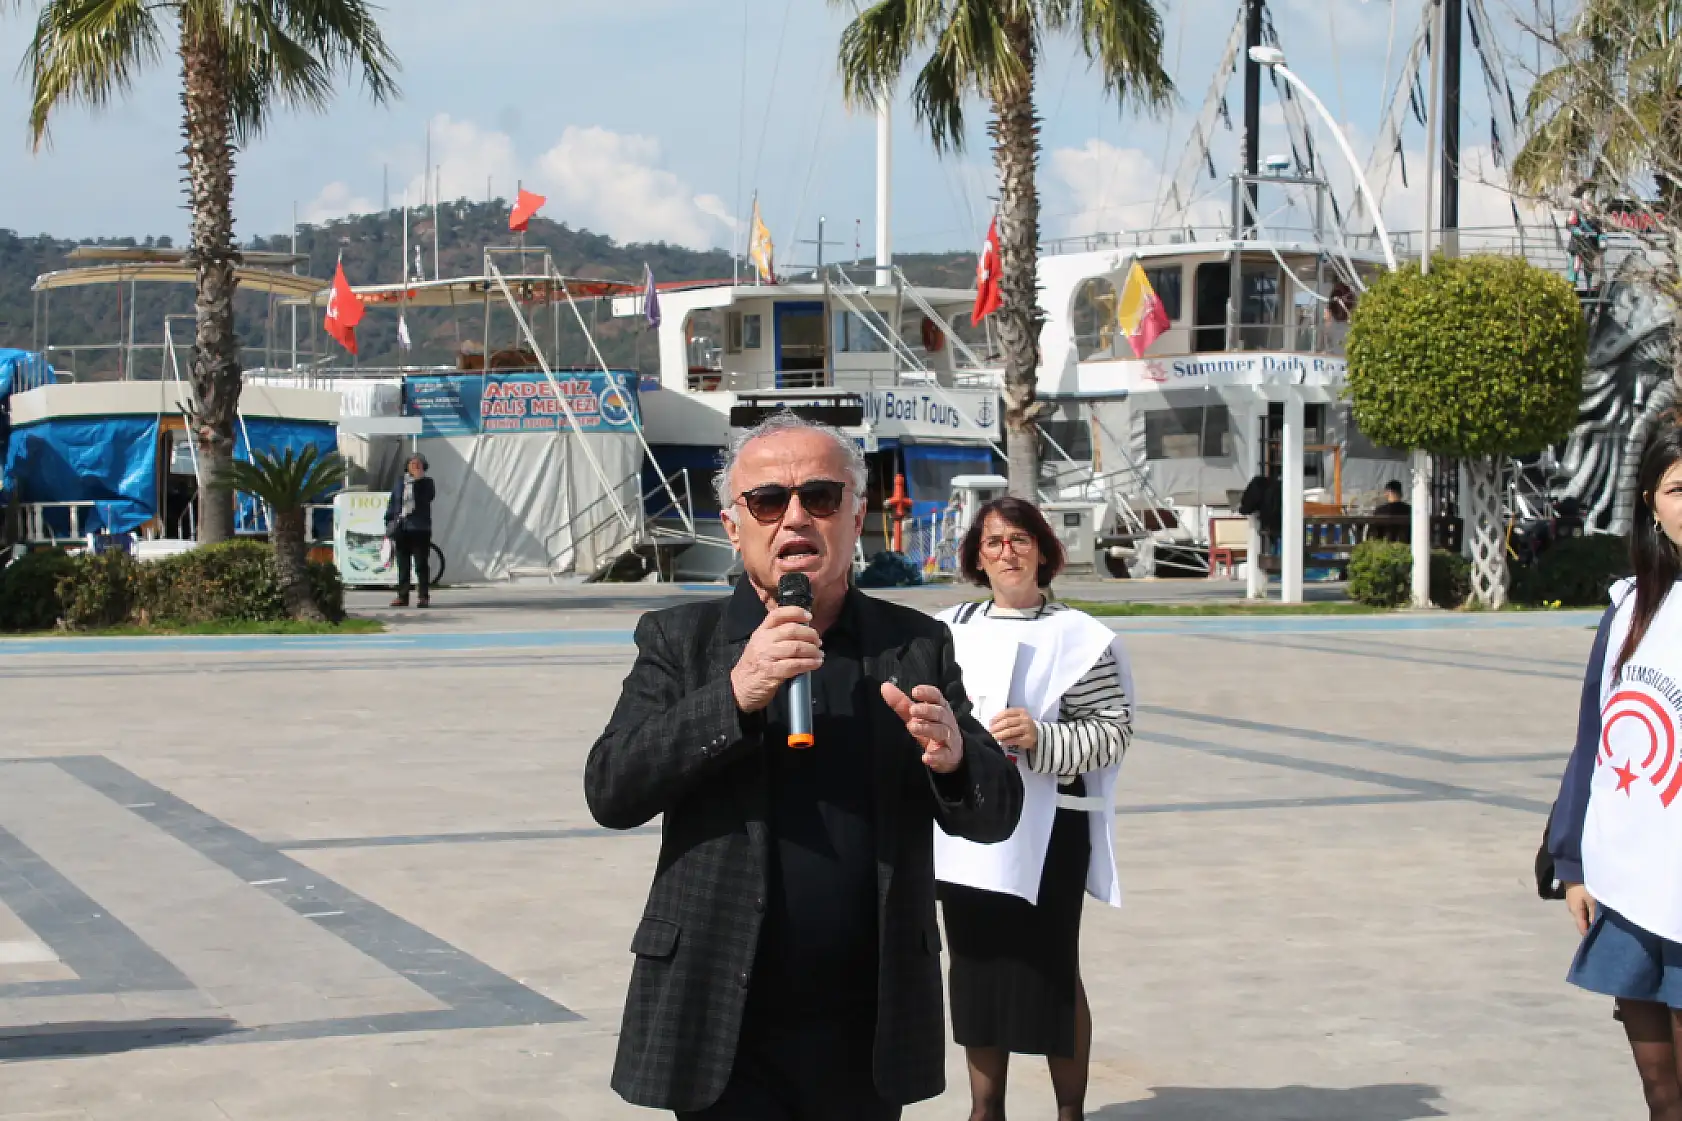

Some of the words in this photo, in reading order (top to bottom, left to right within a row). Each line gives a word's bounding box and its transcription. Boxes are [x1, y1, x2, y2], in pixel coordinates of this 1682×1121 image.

[1171, 358, 1255, 378] Summer
[1262, 355, 1306, 384] Daily
[1313, 358, 1349, 373] Boa
[885, 391, 917, 421] Boat
[921, 395, 960, 429] Tours
